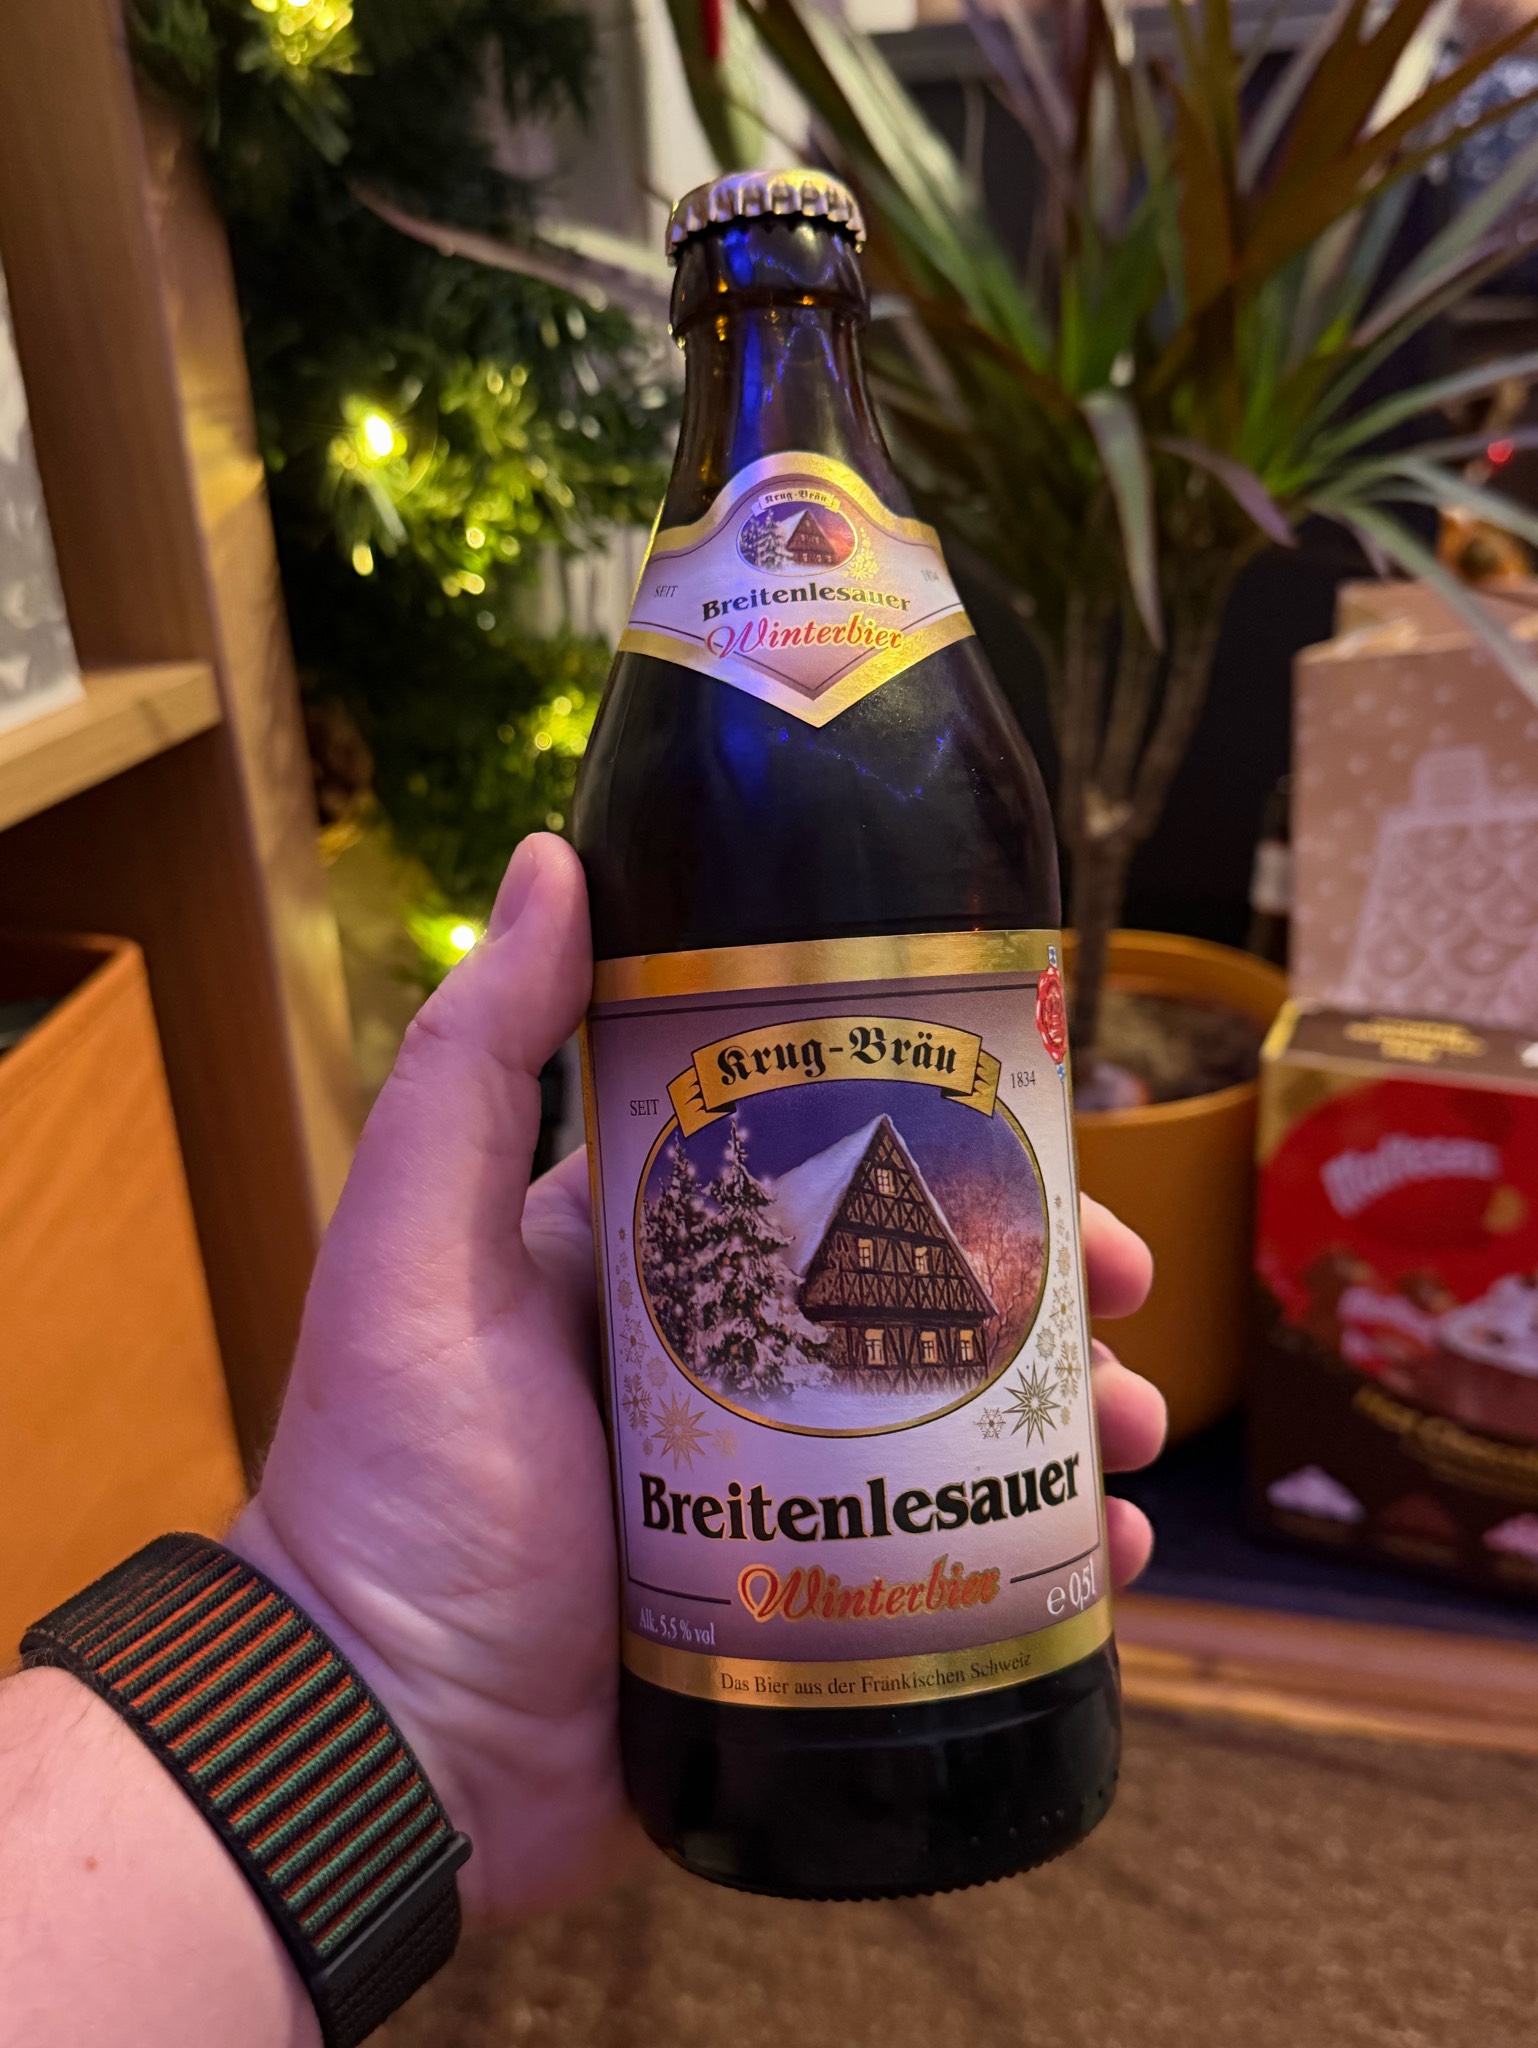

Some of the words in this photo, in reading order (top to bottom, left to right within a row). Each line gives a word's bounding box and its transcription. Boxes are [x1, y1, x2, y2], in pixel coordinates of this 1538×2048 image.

[702, 582, 911, 622] Breitenlesauer
[704, 614, 902, 659] Winterbier
[717, 1026, 958, 1086] Krug-Bräu
[1010, 1070, 1036, 1089] 1834
[629, 1098, 660, 1117] SEIT
[639, 1452, 1081, 1542] Breitenlesauer
[737, 1554, 1000, 1623] Winterbier
[660, 1614, 678, 1639] 5,5
[679, 1619, 692, 1640] %
[694, 1621, 716, 1645] vol
[721, 1673, 750, 1691] Das
[754, 1676, 790, 1694] Bier
[794, 1681, 823, 1694] aus
[828, 1677, 857, 1694] der
[862, 1668, 966, 1693] Fränkischen
[970, 1652, 1032, 1679] Schweiz
